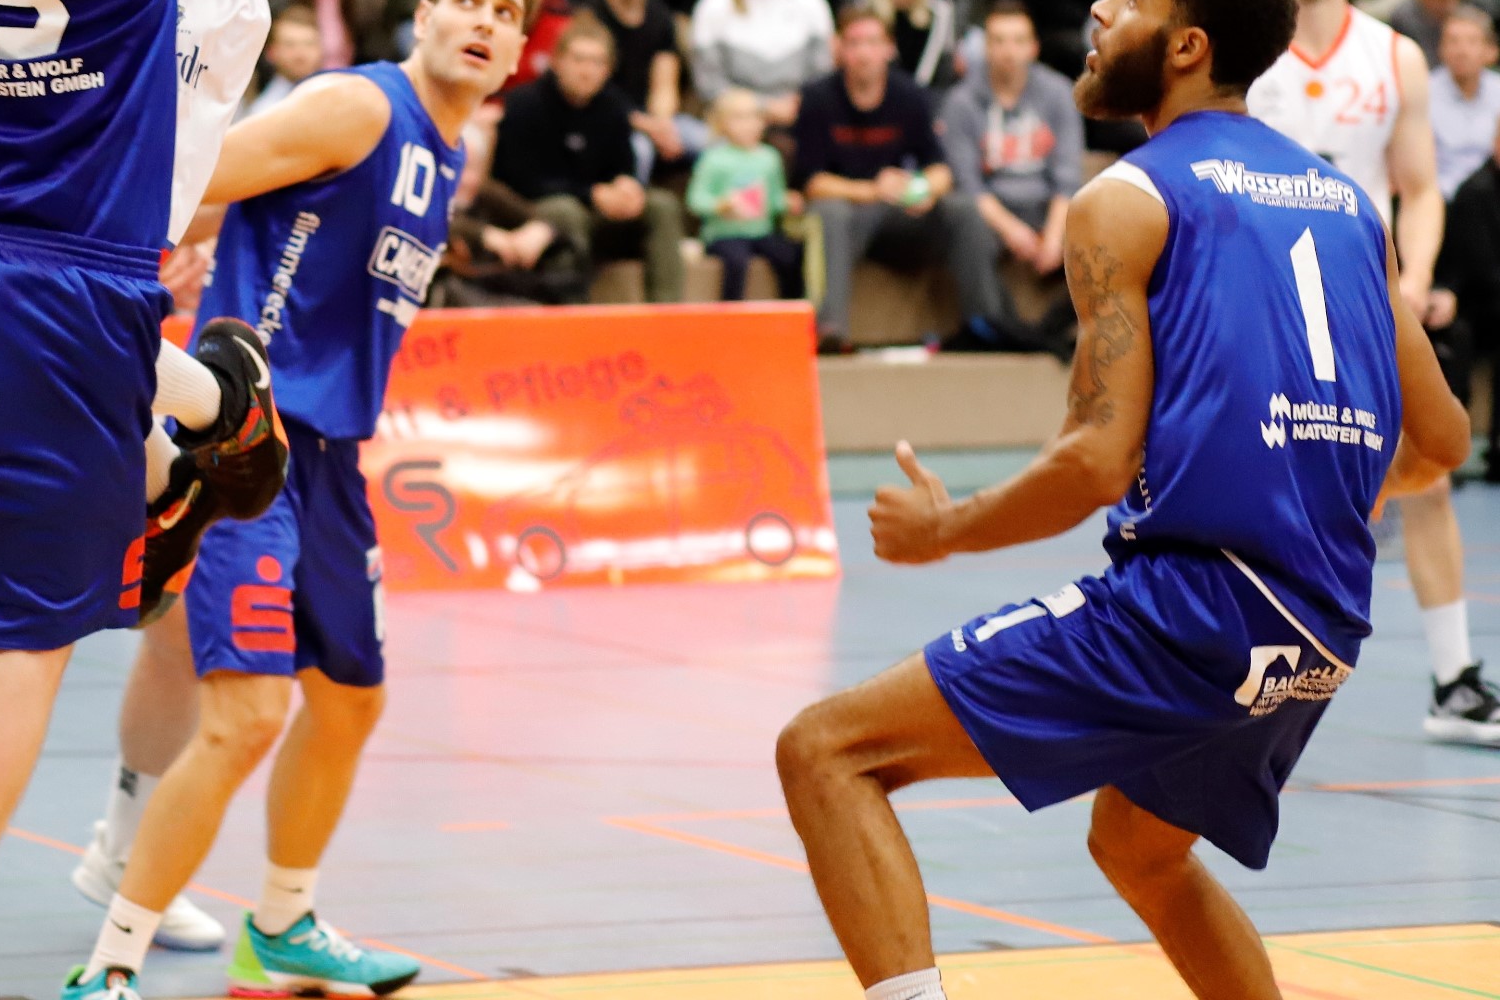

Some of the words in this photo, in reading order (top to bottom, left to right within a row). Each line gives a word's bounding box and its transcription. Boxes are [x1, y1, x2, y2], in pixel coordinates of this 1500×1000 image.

[11, 63, 28, 79] &
[28, 57, 84, 78] WOLF
[50, 71, 105, 94] GMBH
[1334, 80, 1388, 125] 24
[390, 140, 437, 218] 10
[1190, 159, 1358, 217] Wassenberg
[1289, 225, 1337, 382] 1
[1340, 407, 1353, 424] &
